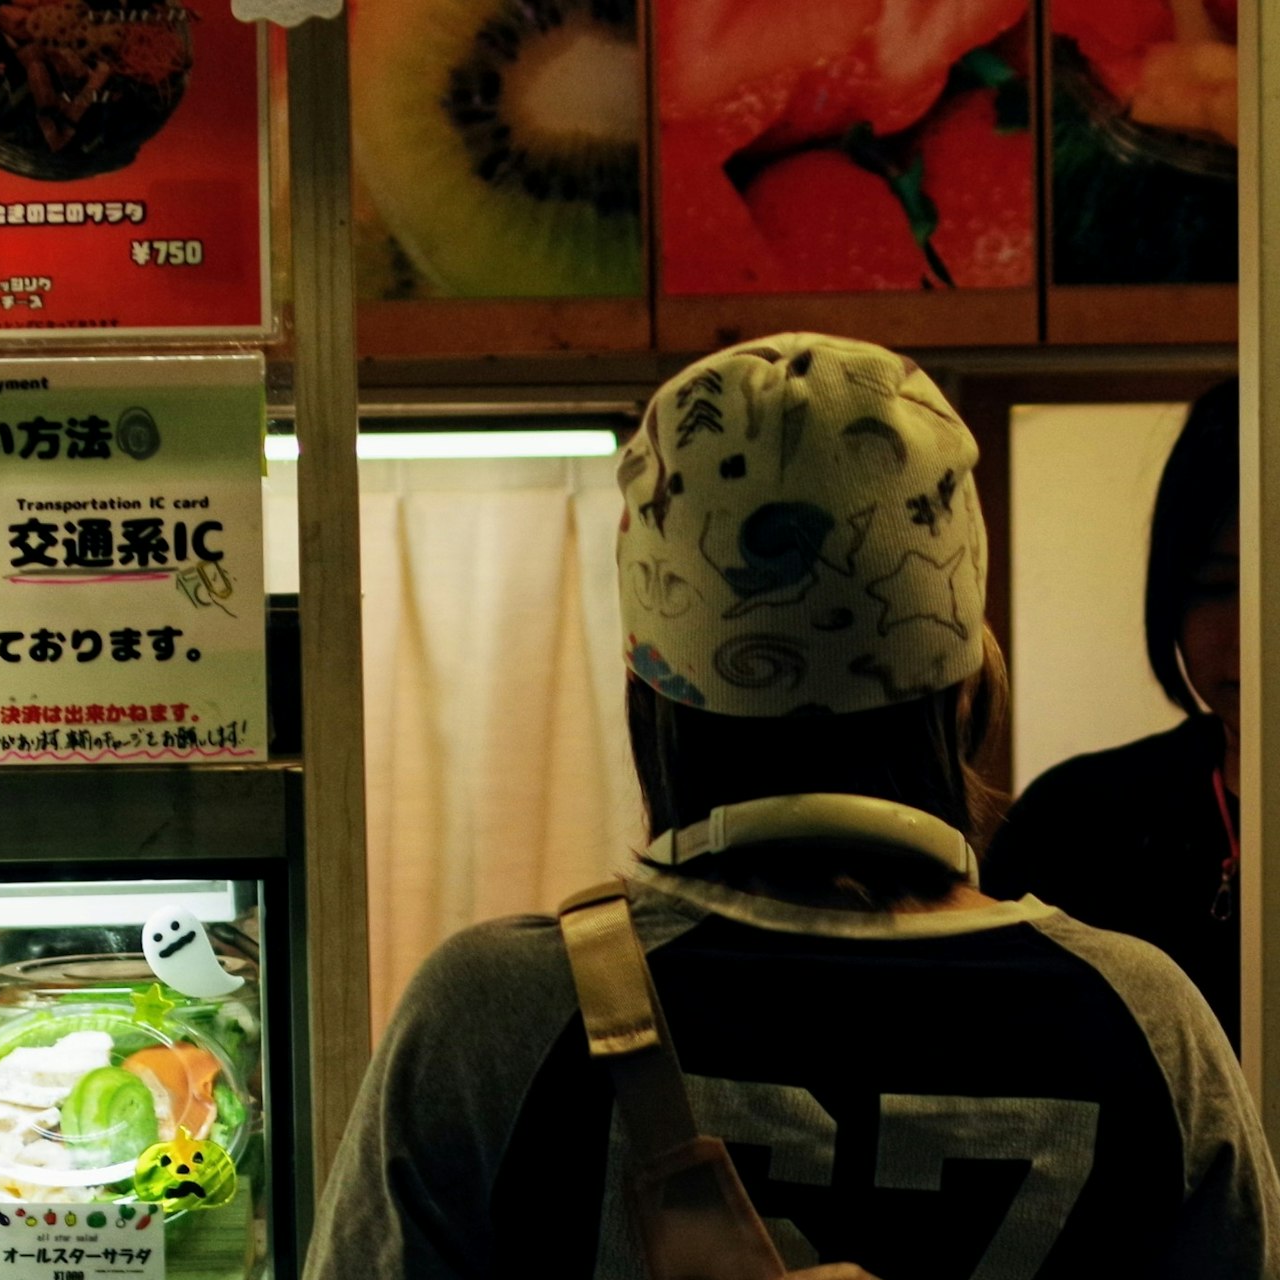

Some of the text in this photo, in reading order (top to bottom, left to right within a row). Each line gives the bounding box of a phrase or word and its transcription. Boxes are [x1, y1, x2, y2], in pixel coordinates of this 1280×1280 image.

[131, 240, 204, 267] ¥750
[16, 497, 143, 514] Transportation
[149, 497, 166, 511] IC
[172, 496, 210, 511] card
[7, 518, 225, 569] 交通系IC
[2, 1247, 153, 1265] オールスターサラダ
